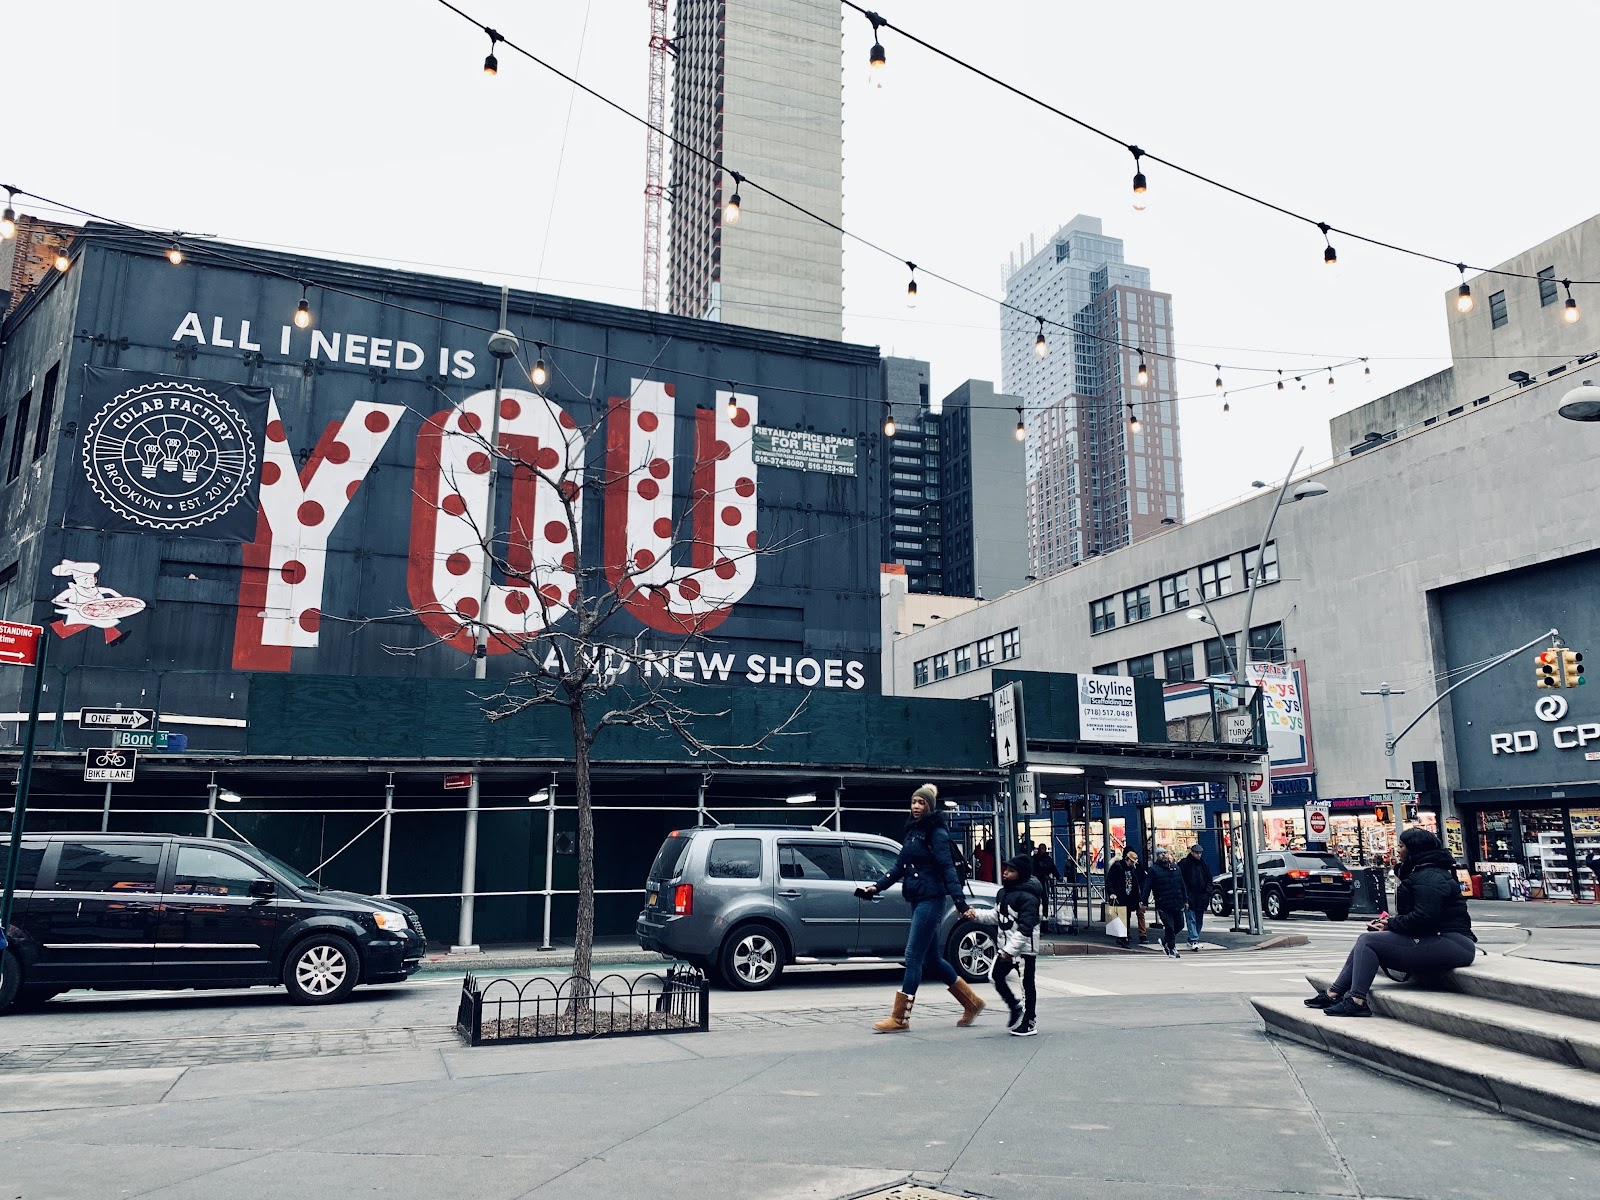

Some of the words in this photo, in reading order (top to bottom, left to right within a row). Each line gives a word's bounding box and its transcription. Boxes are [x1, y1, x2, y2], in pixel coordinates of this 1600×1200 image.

[172, 311, 261, 352] ALL
[280, 325, 292, 355] I
[309, 329, 425, 371] NEED
[439, 346, 477, 380] IS
[112, 398, 165, 430] COLAB
[169, 397, 235, 442] FACTORY
[755, 426, 822, 443] RETAIL/OFFICE
[825, 435, 855, 447] SPACE
[771, 436, 799, 450] FOR
[802, 440, 839, 454] RENT
[792, 449, 820, 458] SQUARE
[103, 462, 162, 511] BROOKLYN
[179, 496, 206, 512] EST.
[205, 474, 232, 501] 2016
[259, 377, 758, 648] YOU
[0, 625, 33, 638] STANDING
[645, 648, 736, 682] NEW
[745, 653, 865, 690] SHOES
[1088, 680, 1132, 701] Skyline
[999, 689, 1010, 707] ALL
[1091, 698, 1121, 706] Scaffolding
[91, 714, 112, 723] ONE
[121, 715, 142, 724] WAY
[997, 708, 1014, 727] TRAFFIC
[1084, 708, 1101, 717] (718)
[1102, 709, 1133, 718] 517.0481
[1233, 719, 1245, 727] NO
[1228, 727, 1250, 736] TURNS
[1490, 730, 1539, 755] RD
[87, 769, 106, 778] BIKE
[110, 770, 131, 778] LANE
[1018, 774, 1030, 783] ALL
[1016, 784, 1033, 794] TRAFFIC
[1333, 797, 1364, 808] wonderful
[1193, 815, 1203, 824] 15
